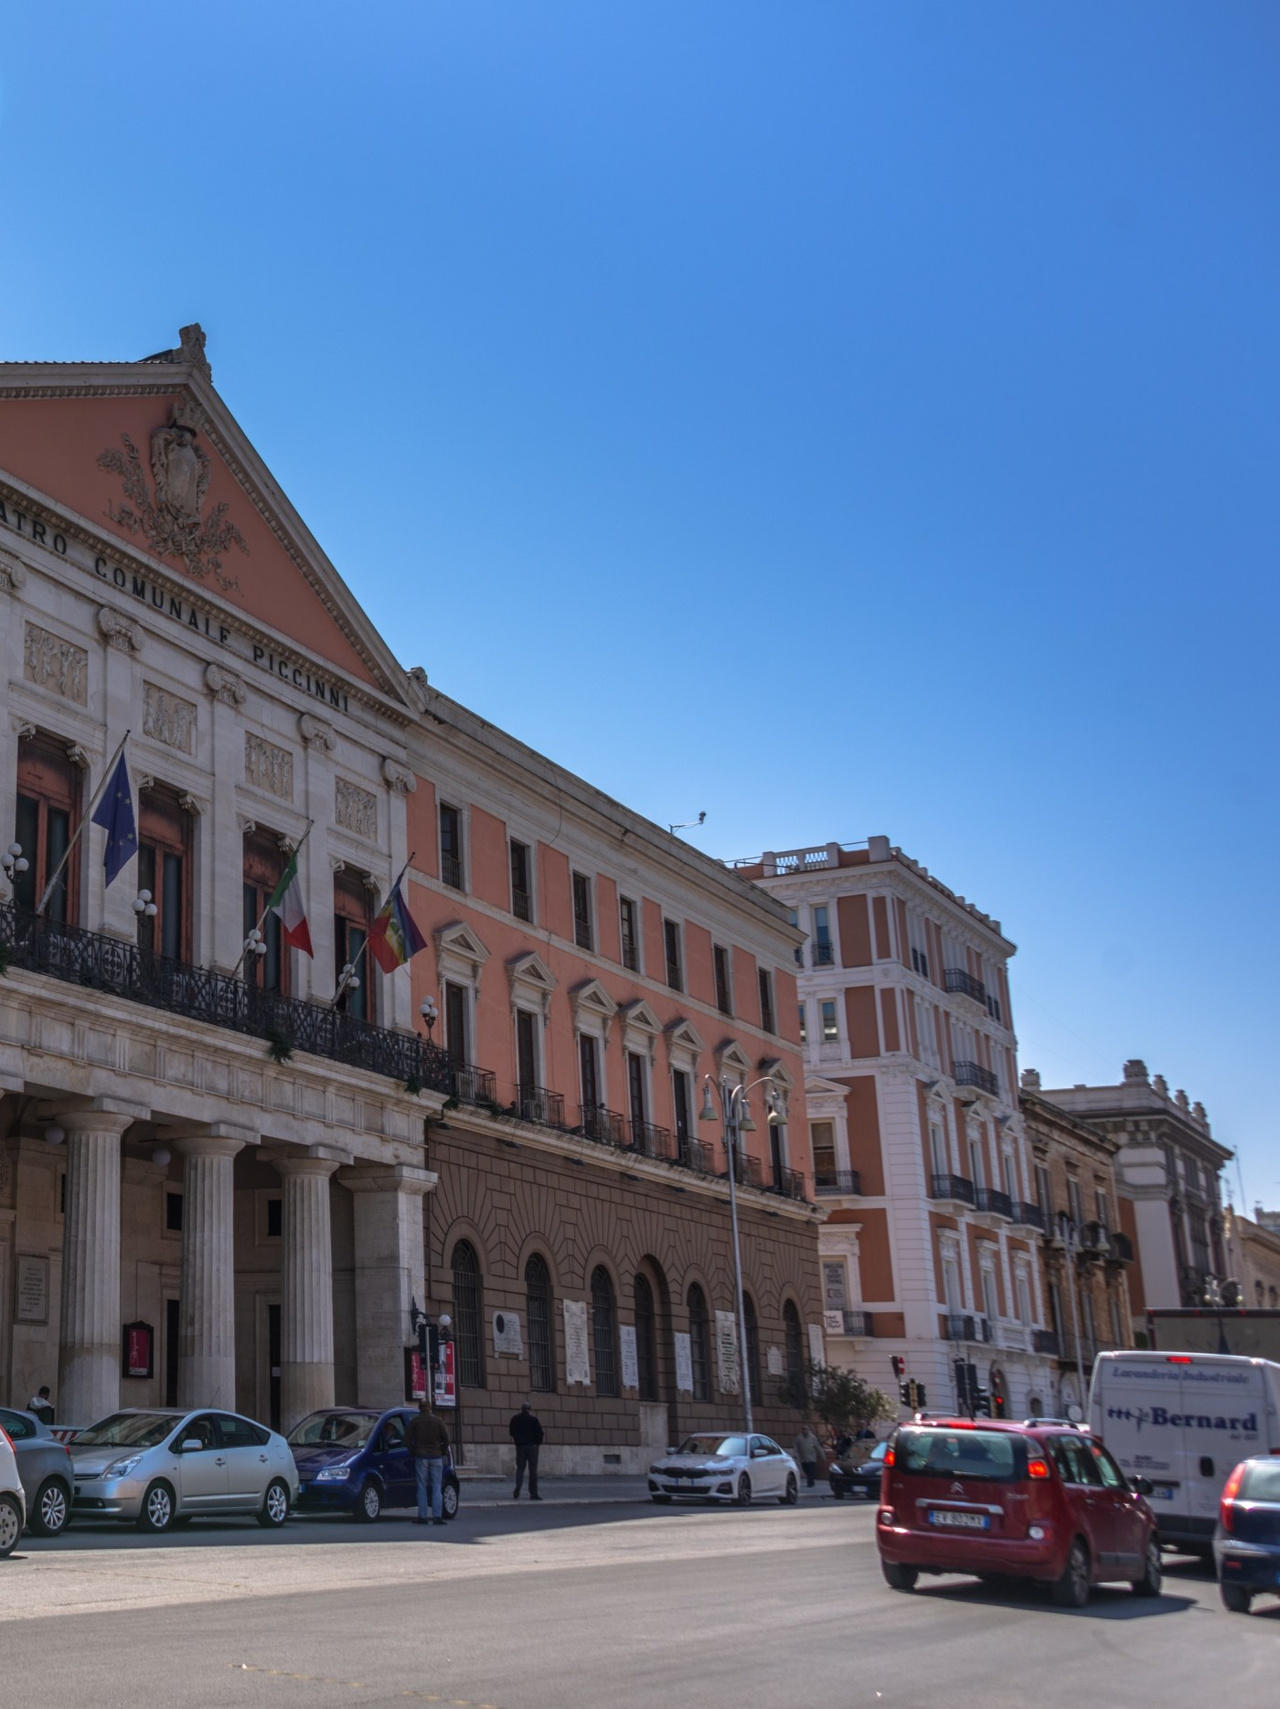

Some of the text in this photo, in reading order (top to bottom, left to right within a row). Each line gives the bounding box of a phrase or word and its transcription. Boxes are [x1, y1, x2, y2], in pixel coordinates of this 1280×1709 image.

[95, 556, 231, 649] COMUNALE
[252, 644, 350, 712] PICCINNI
[1112, 1366, 1250, 1384] Lavanderia Industriale
[1150, 1406, 1258, 1432] Bernard
